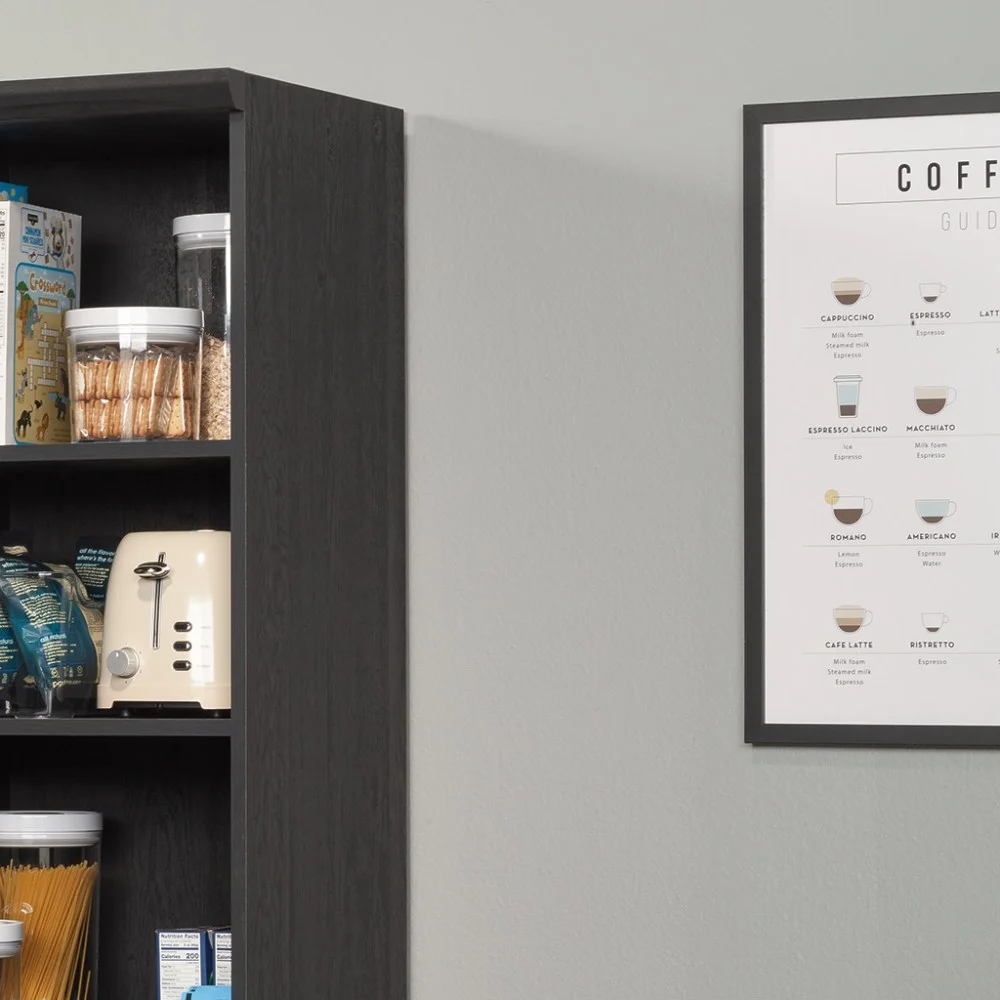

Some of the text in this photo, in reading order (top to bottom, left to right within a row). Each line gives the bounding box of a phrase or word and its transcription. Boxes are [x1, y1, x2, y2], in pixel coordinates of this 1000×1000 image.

[897, 159, 998, 192] COFF
[29, 273, 67, 297] Crossword
[820, 314, 875, 323] CAPPUCCINO
[909, 311, 952, 319] ESPRESSO
[916, 329, 945, 337] Espresso
[833, 352, 862, 360] Espresso
[808, 425, 888, 434] ESPRESSO LACCINO
[906, 424, 956, 432] MACCHIATO
[930, 441, 948, 449] foam
[834, 453, 863, 461] Espresso
[916, 452, 946, 460] Espresso
[906, 532, 957, 540] AMERICANO
[917, 550, 947, 558] Espresso
[834, 561, 864, 569] Espresso
[825, 641, 874, 649] CAFE LATTE
[910, 641, 955, 649] RISTRETTO
[917, 658, 947, 666] Espresso
[835, 678, 864, 686] Espresso
